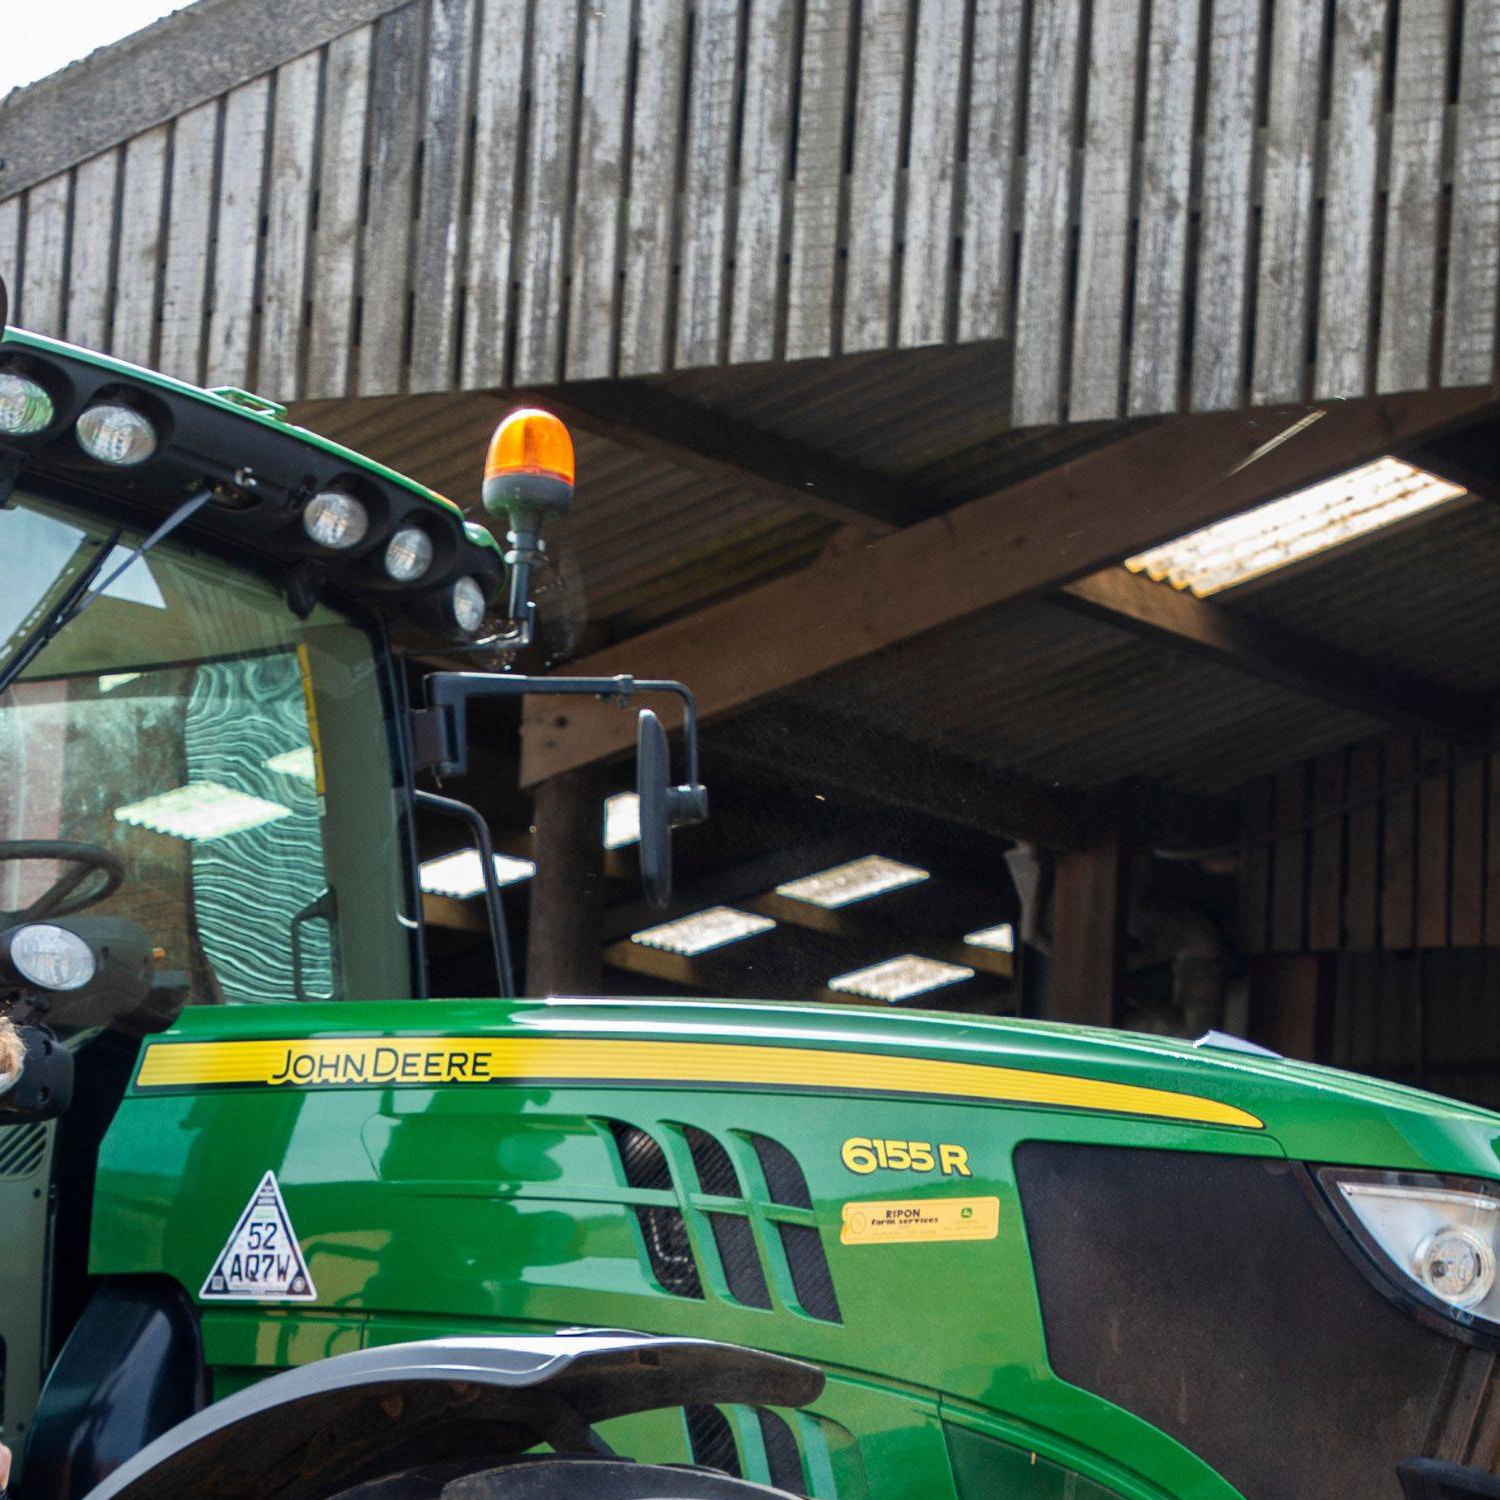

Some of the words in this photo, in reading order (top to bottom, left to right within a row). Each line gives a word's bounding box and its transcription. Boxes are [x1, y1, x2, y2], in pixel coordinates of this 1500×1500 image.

[272, 1049, 366, 1080] JOHN
[372, 1047, 492, 1078] DEERE
[885, 1208, 921, 1219] RIPON
[898, 1217, 939, 1225] services
[248, 1222, 278, 1250] 52
[229, 1253, 291, 1282] AQ7W
